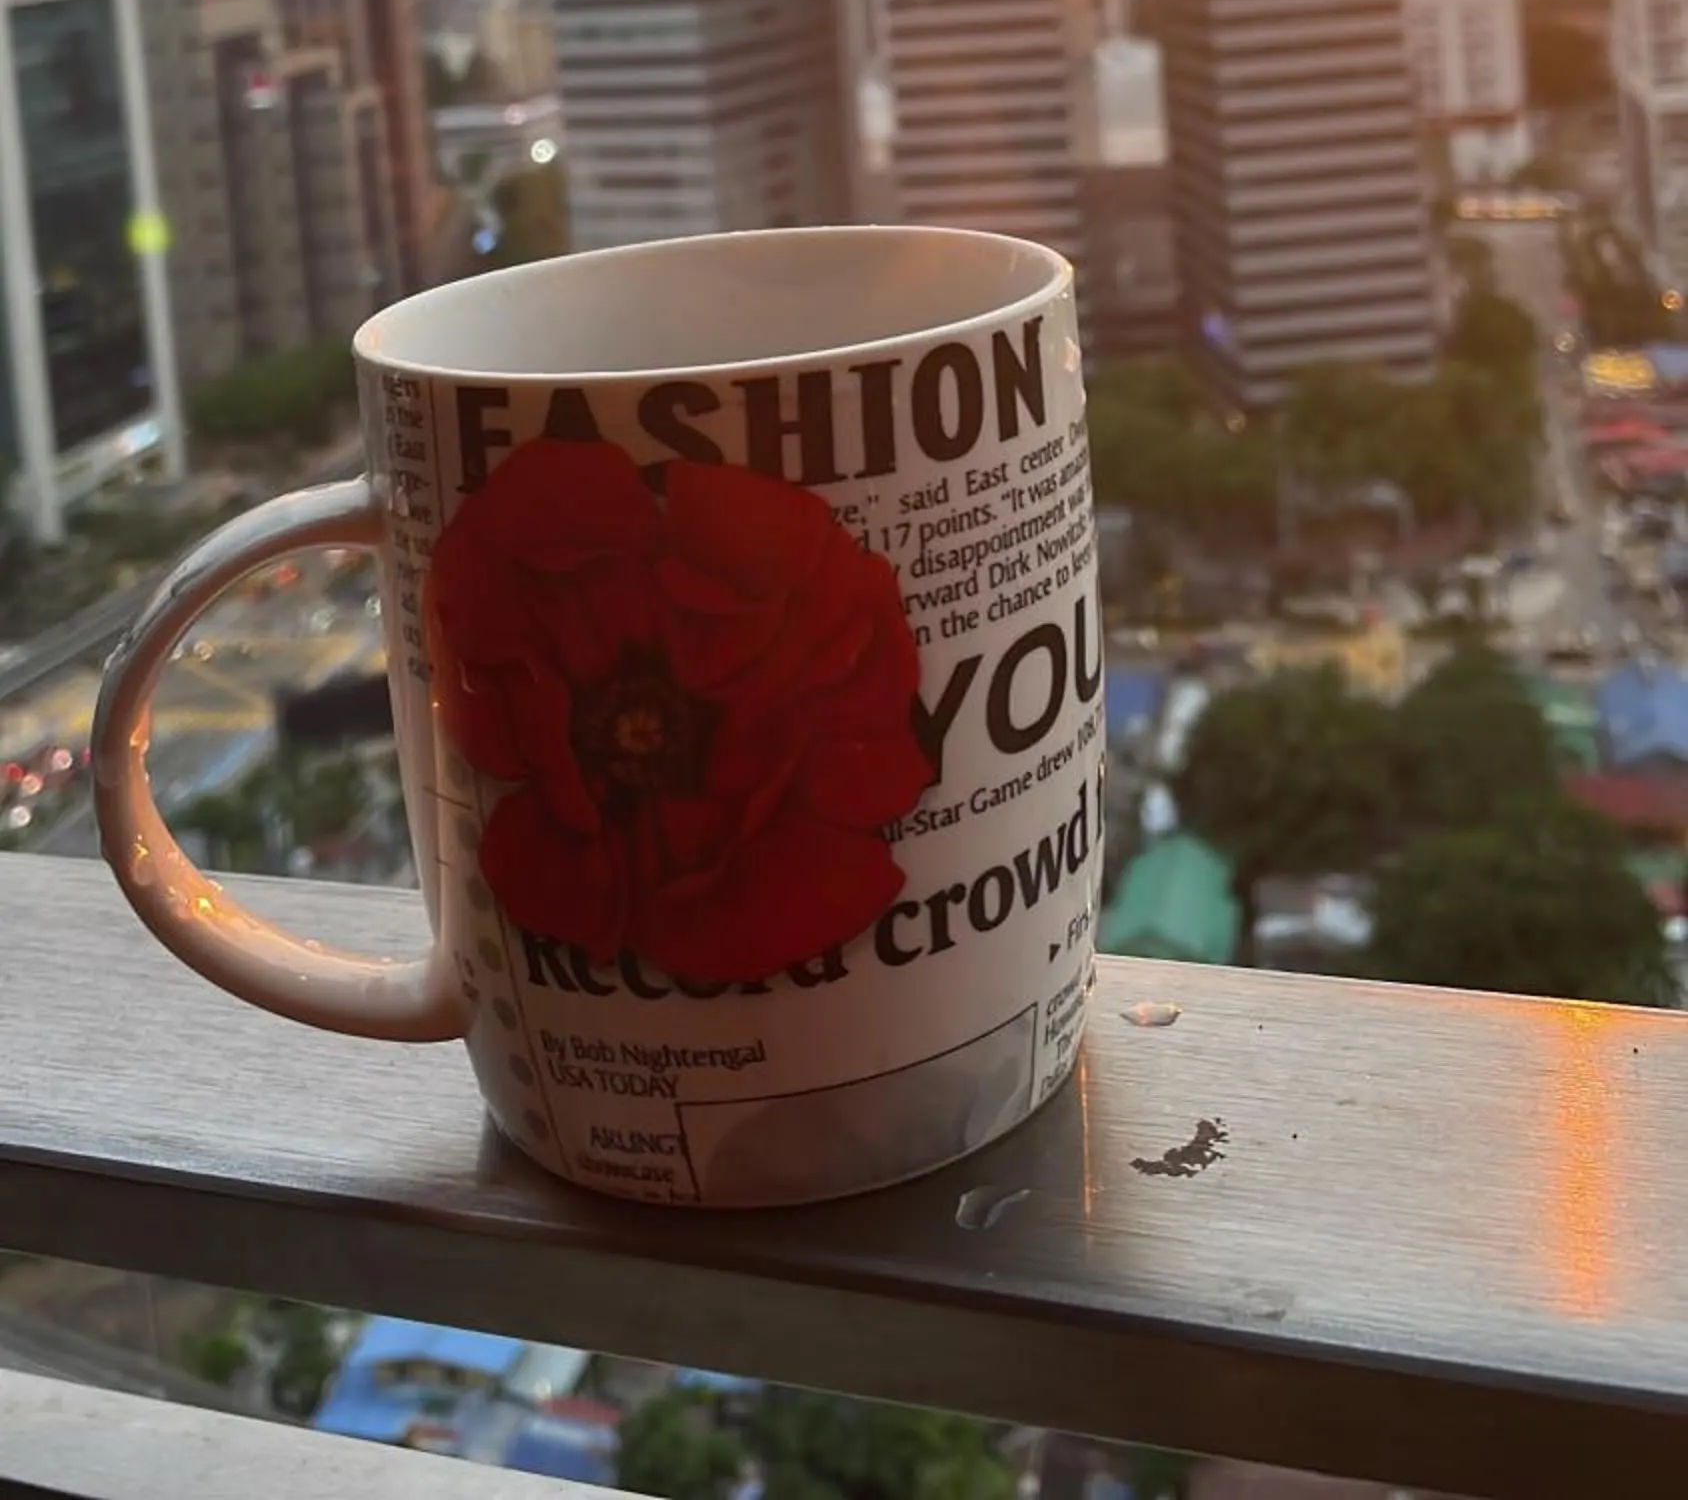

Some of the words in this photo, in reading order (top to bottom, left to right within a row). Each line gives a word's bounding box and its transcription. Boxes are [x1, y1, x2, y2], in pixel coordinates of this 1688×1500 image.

[455, 314, 1047, 497] FASHION
[880, 522, 911, 552] 17
[919, 503, 998, 544] points.
[1027, 471, 1057, 502] was
[898, 477, 950, 515] said
[964, 461, 1009, 497] East
[1020, 435, 1065, 475] center
[910, 499, 1066, 580] disappointment
[904, 572, 980, 617] rward
[988, 550, 1032, 590] Dirk
[940, 607, 980, 642] the
[986, 575, 1052, 622] chance
[1056, 563, 1070, 590] to
[910, 594, 1102, 787] YOU
[969, 773, 1033, 816] Game
[1036, 738, 1075, 784] drew
[873, 777, 1090, 967] crowd
[539, 1029, 566, 1061] By
[573, 1034, 617, 1065] Bob
[620, 1038, 768, 1074] Nightengal
[548, 1059, 594, 1090] USA
[594, 1068, 682, 1100] TODAY
